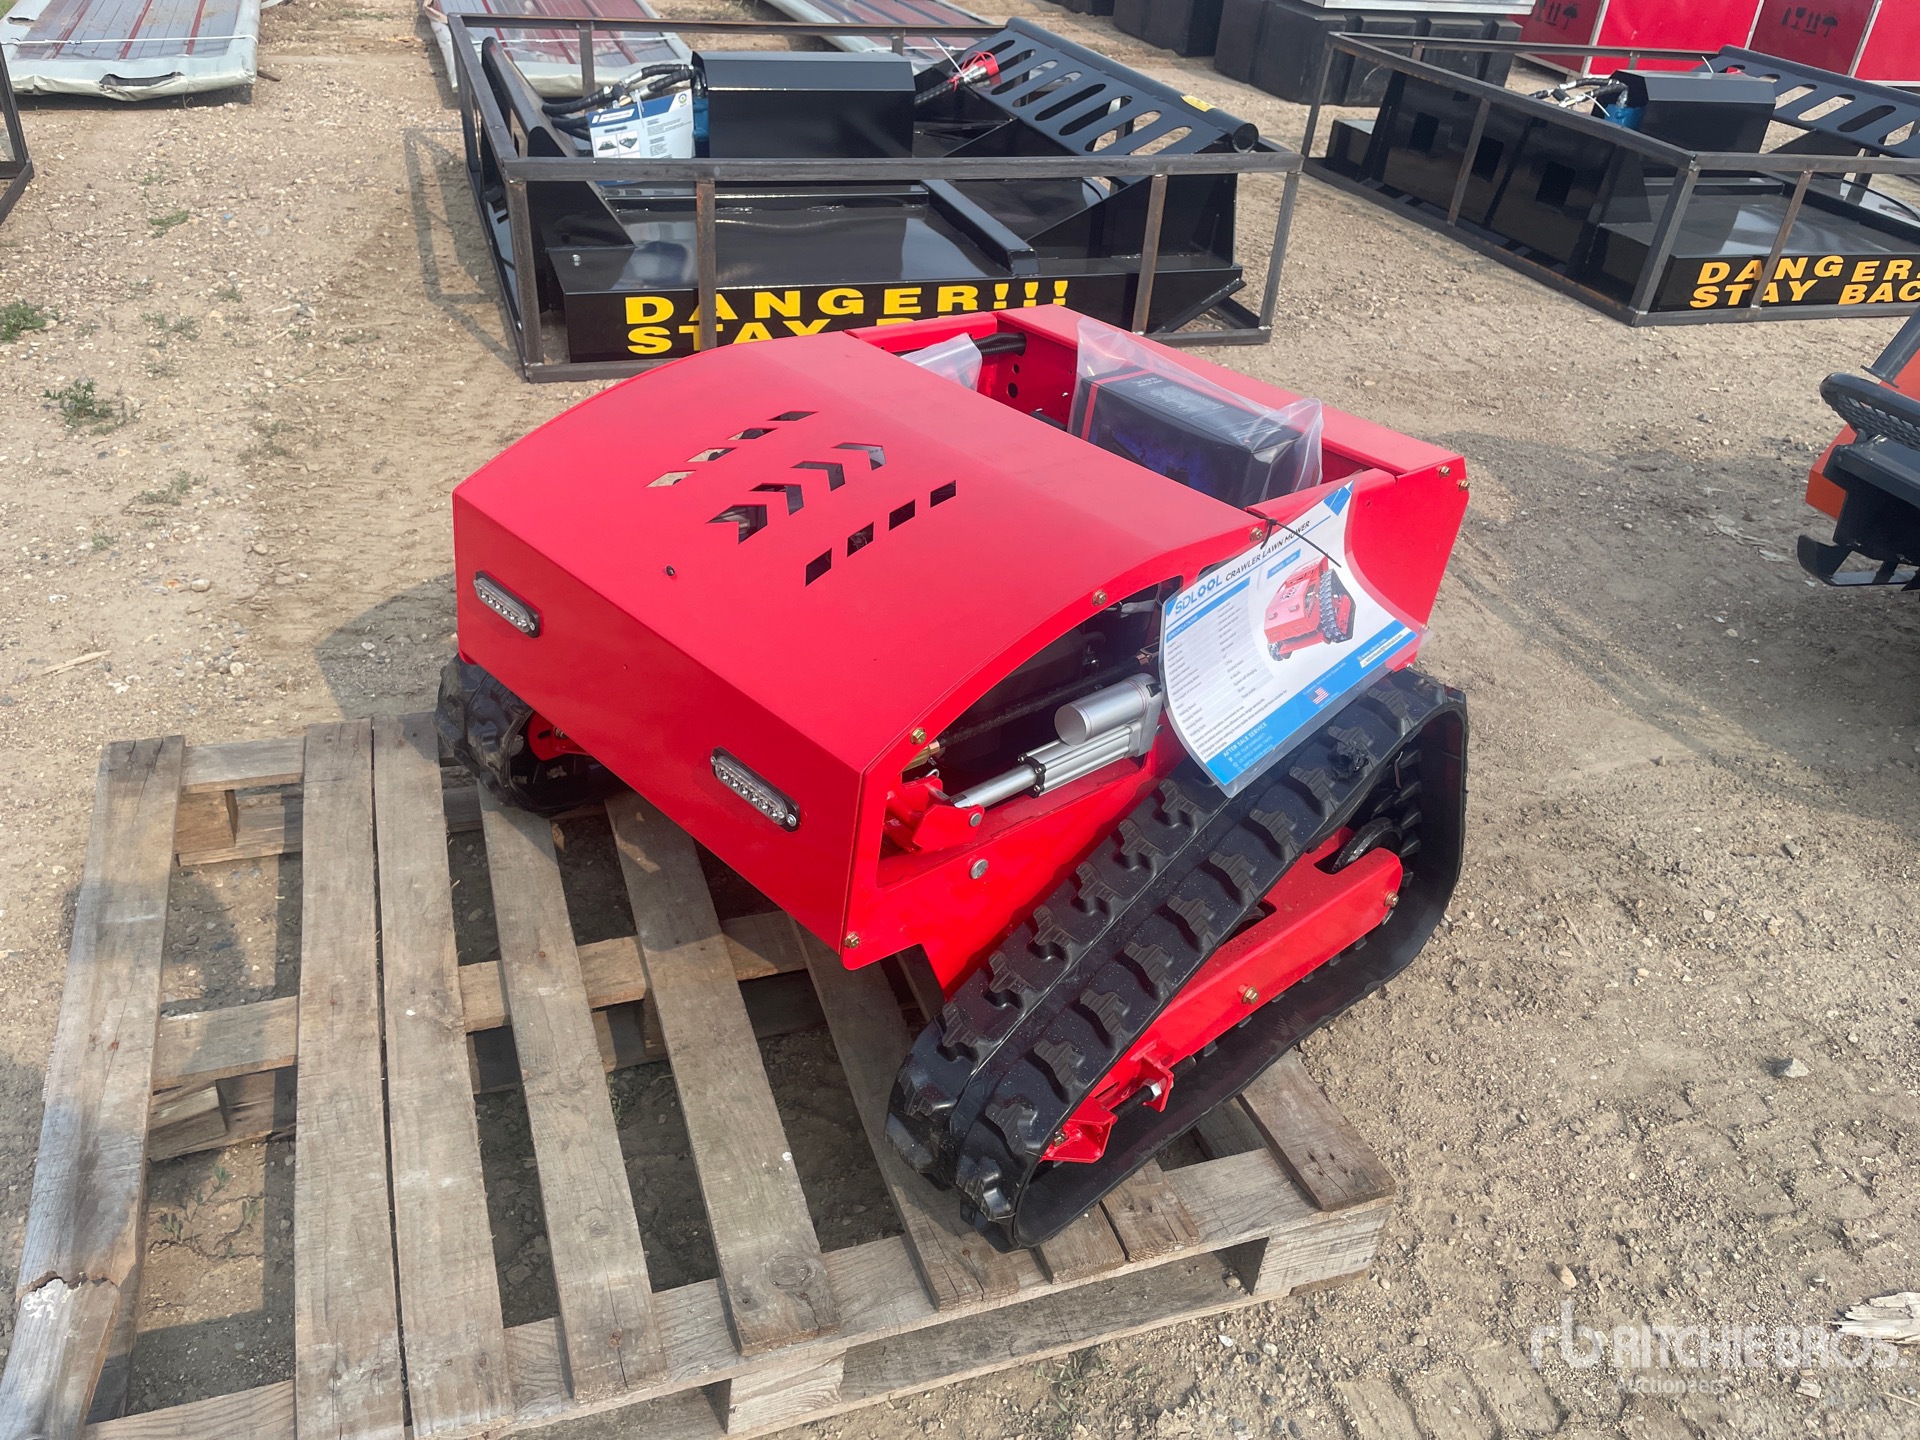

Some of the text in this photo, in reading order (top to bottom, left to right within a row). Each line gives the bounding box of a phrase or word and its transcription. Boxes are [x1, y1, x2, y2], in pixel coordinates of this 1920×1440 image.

[1697, 255, 1920, 285] DANGER
[625, 280, 1069, 325] DANGER!!!
[1689, 279, 1818, 309] STAY
[627, 318, 832, 355] STAY
[1175, 575, 1223, 615] SDLOOL
[1225, 553, 1262, 582] CRAWLER
[1262, 539, 1284, 560] LAWN
[1283, 520, 1311, 544] MOWER
[1223, 721, 1268, 757] AFTER SALE SERVICE
